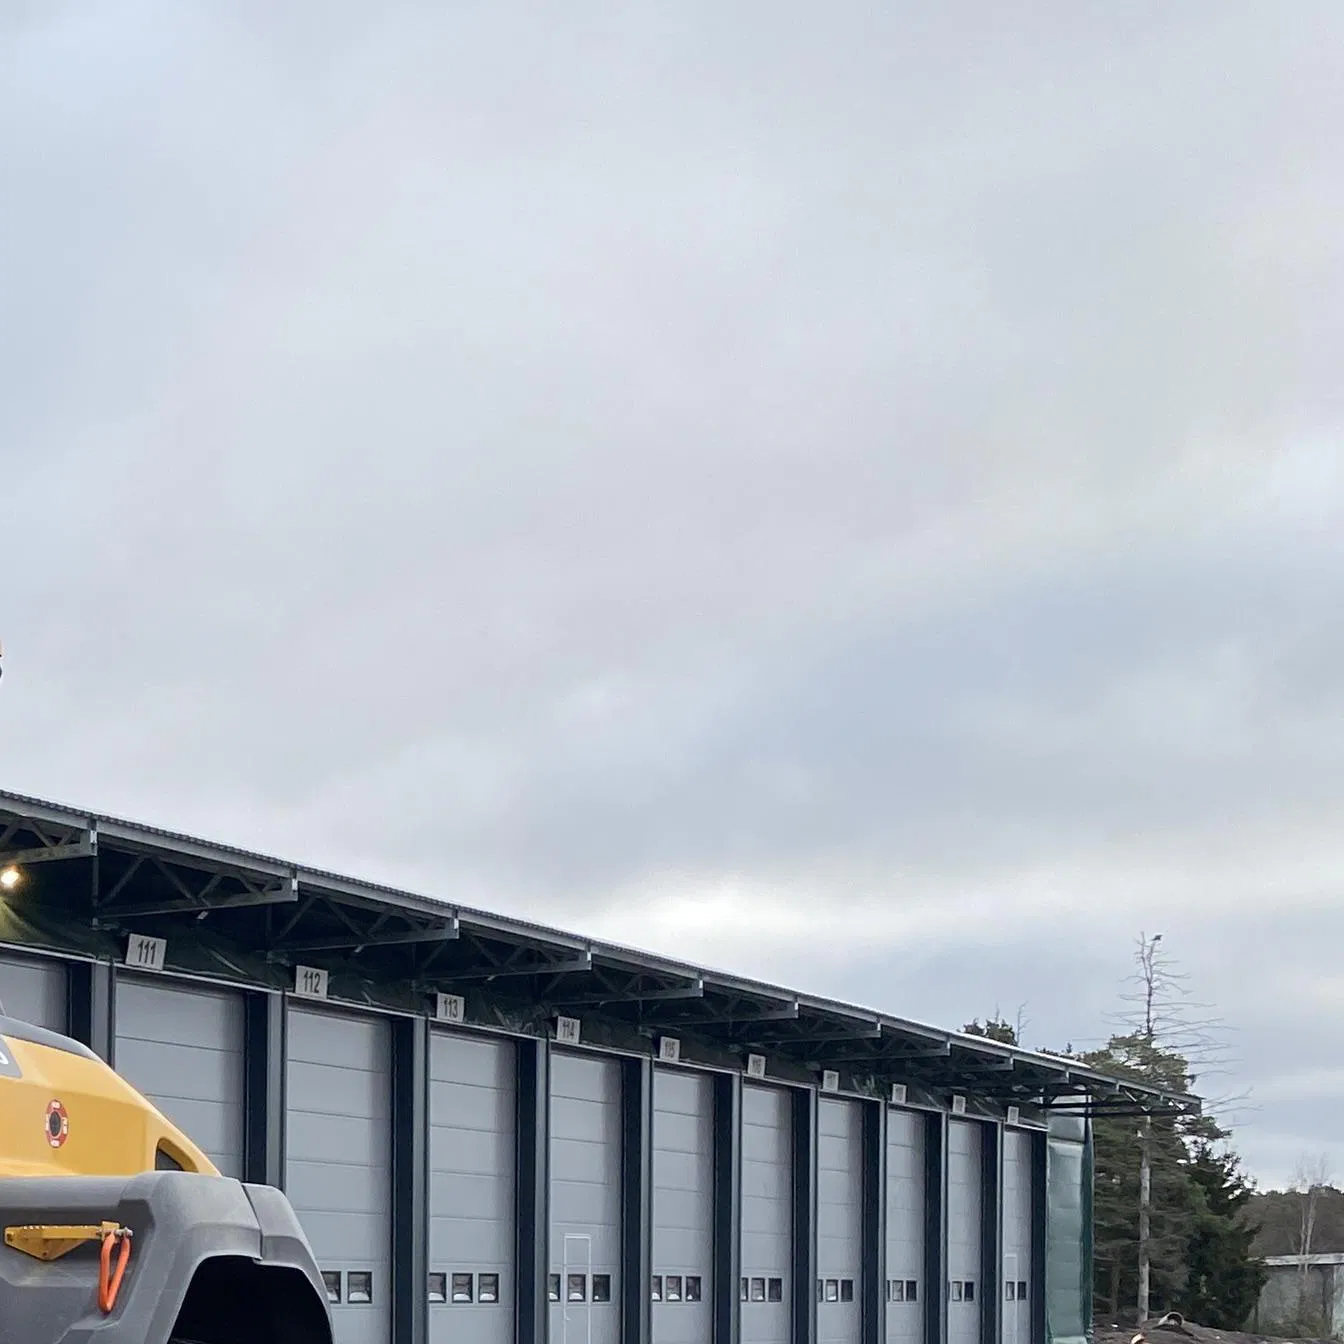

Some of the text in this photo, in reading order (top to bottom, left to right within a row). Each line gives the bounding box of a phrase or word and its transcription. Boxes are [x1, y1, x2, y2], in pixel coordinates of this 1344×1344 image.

[137, 939, 157, 965] 111
[304, 970, 321, 993] 112
[443, 997, 458, 1019] 113
